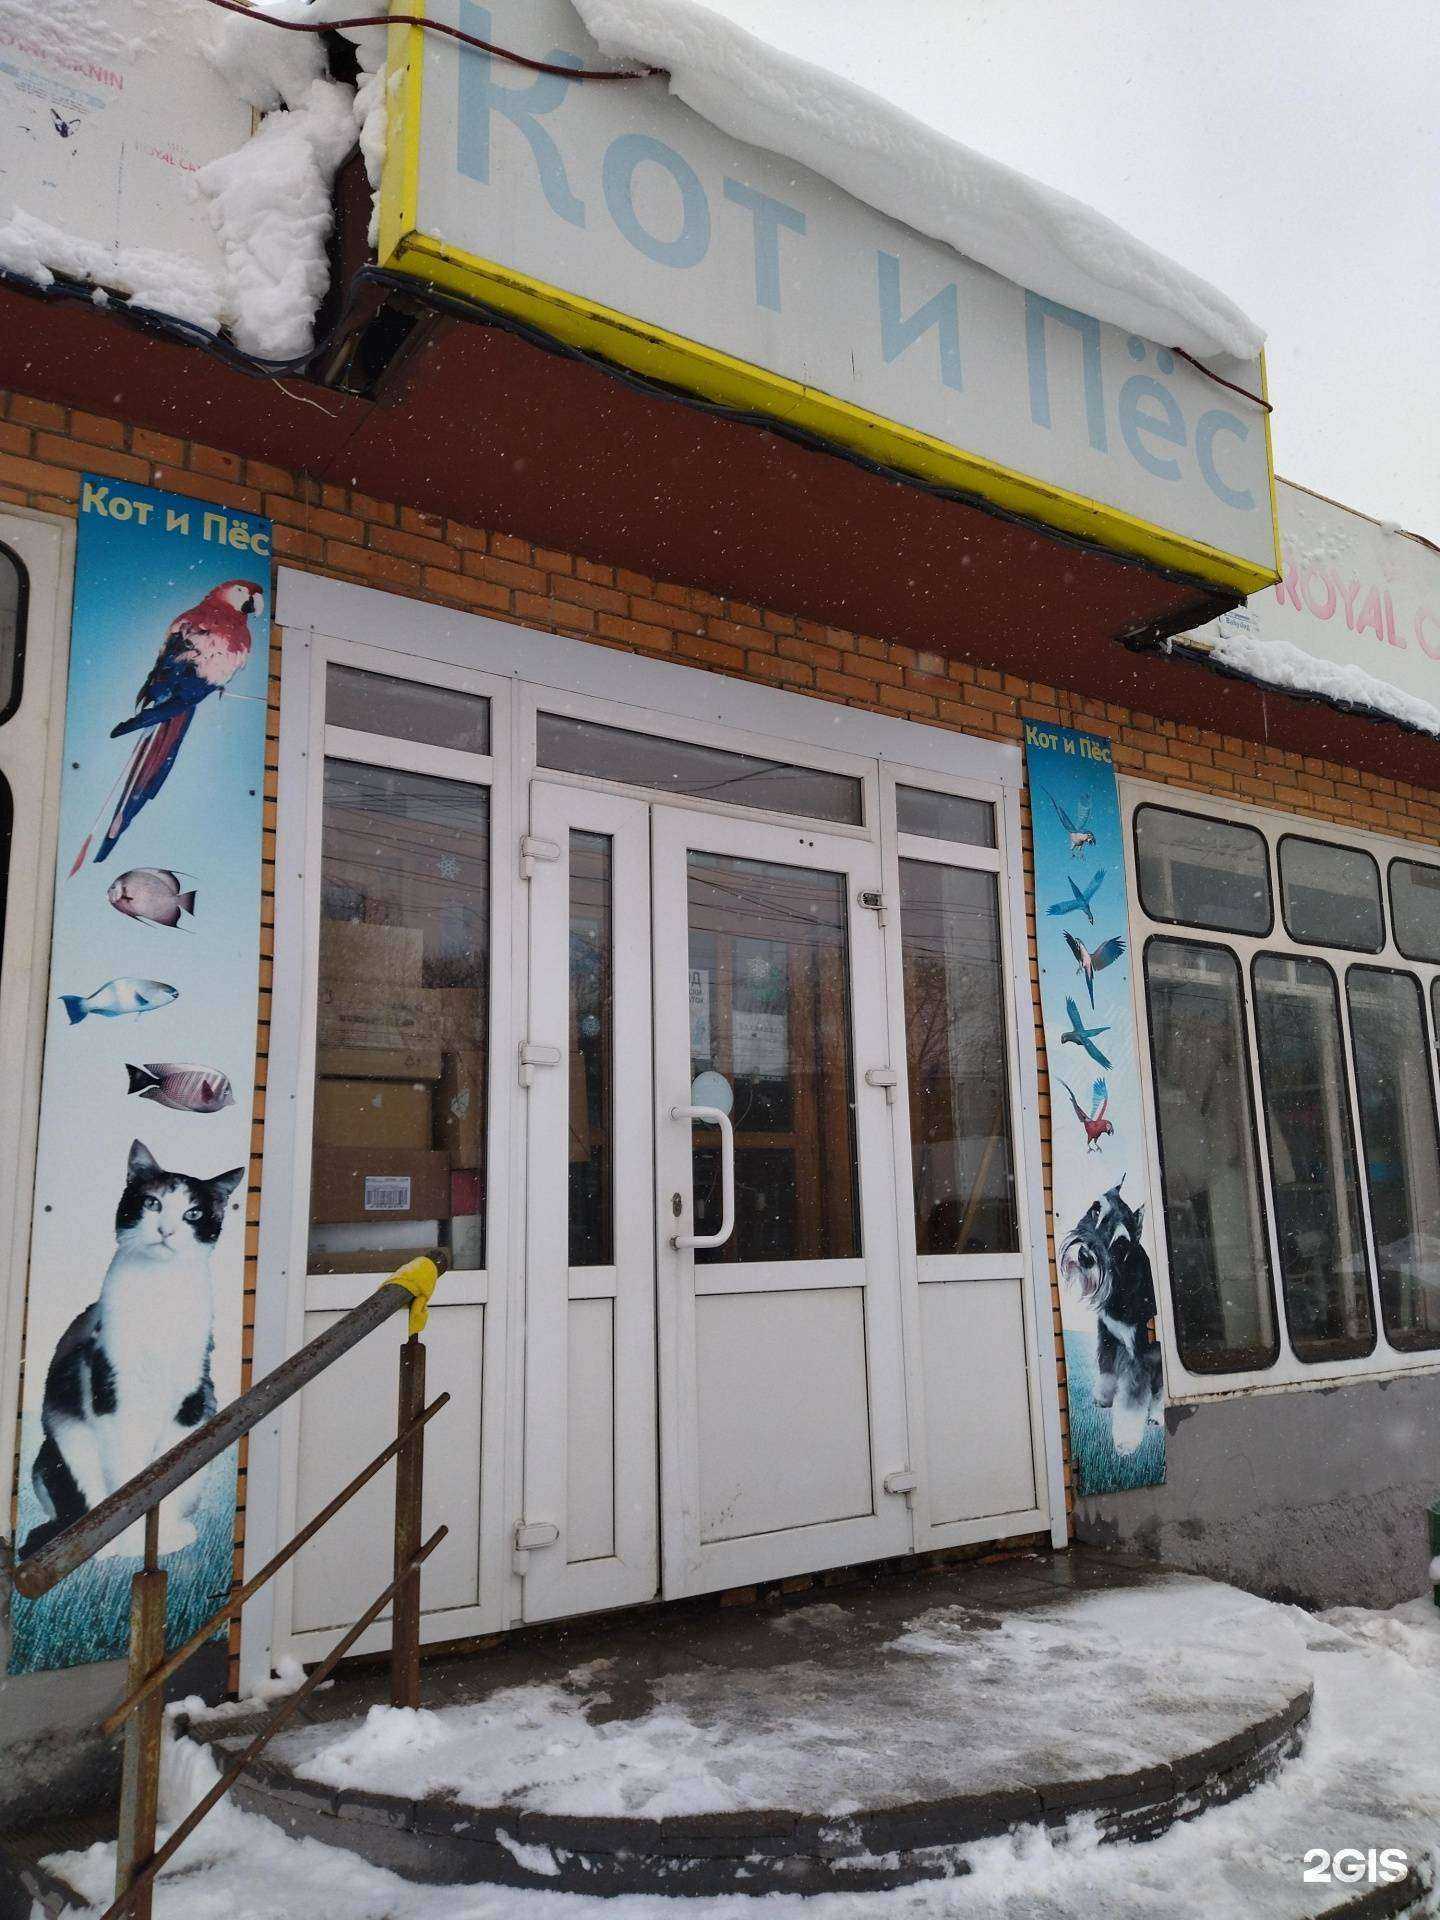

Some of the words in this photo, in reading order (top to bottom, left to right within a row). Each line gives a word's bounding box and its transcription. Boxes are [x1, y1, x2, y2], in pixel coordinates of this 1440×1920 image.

[457, 0, 807, 313] Кот
[878, 249, 963, 392] и
[1025, 288, 1257, 512] Пёс
[82, 482, 154, 526] Кот
[166, 509, 190, 535] и
[203, 511, 271, 556] Пёс
[1025, 724, 1058, 750] Кот
[1063, 737, 1075, 755] и
[1080, 737, 1112, 764] Пёс
